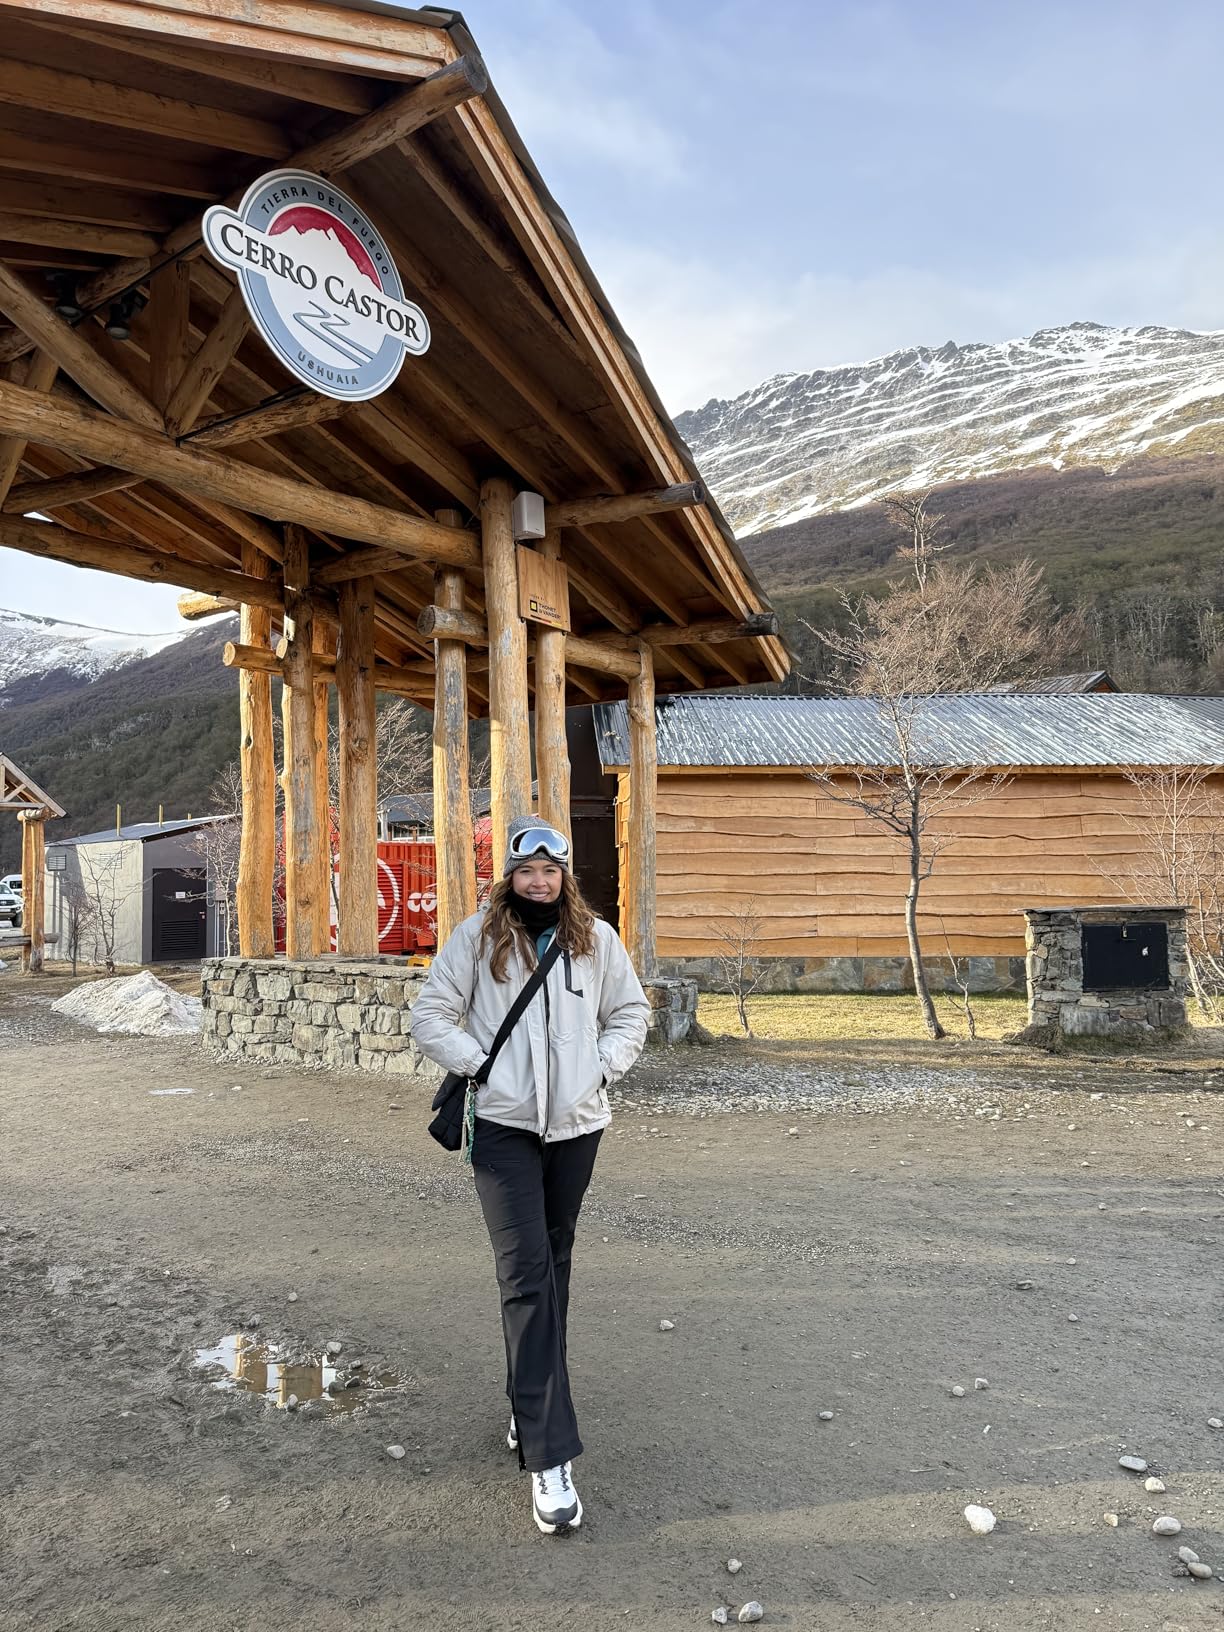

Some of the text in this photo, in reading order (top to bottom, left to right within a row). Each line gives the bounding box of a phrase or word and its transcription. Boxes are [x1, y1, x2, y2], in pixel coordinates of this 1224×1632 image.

[261, 187, 389, 275] TIERRA DEL FUEGO
[220, 223, 421, 342] CERRO CASTOR
[297, 350, 359, 385] USHUAIA
